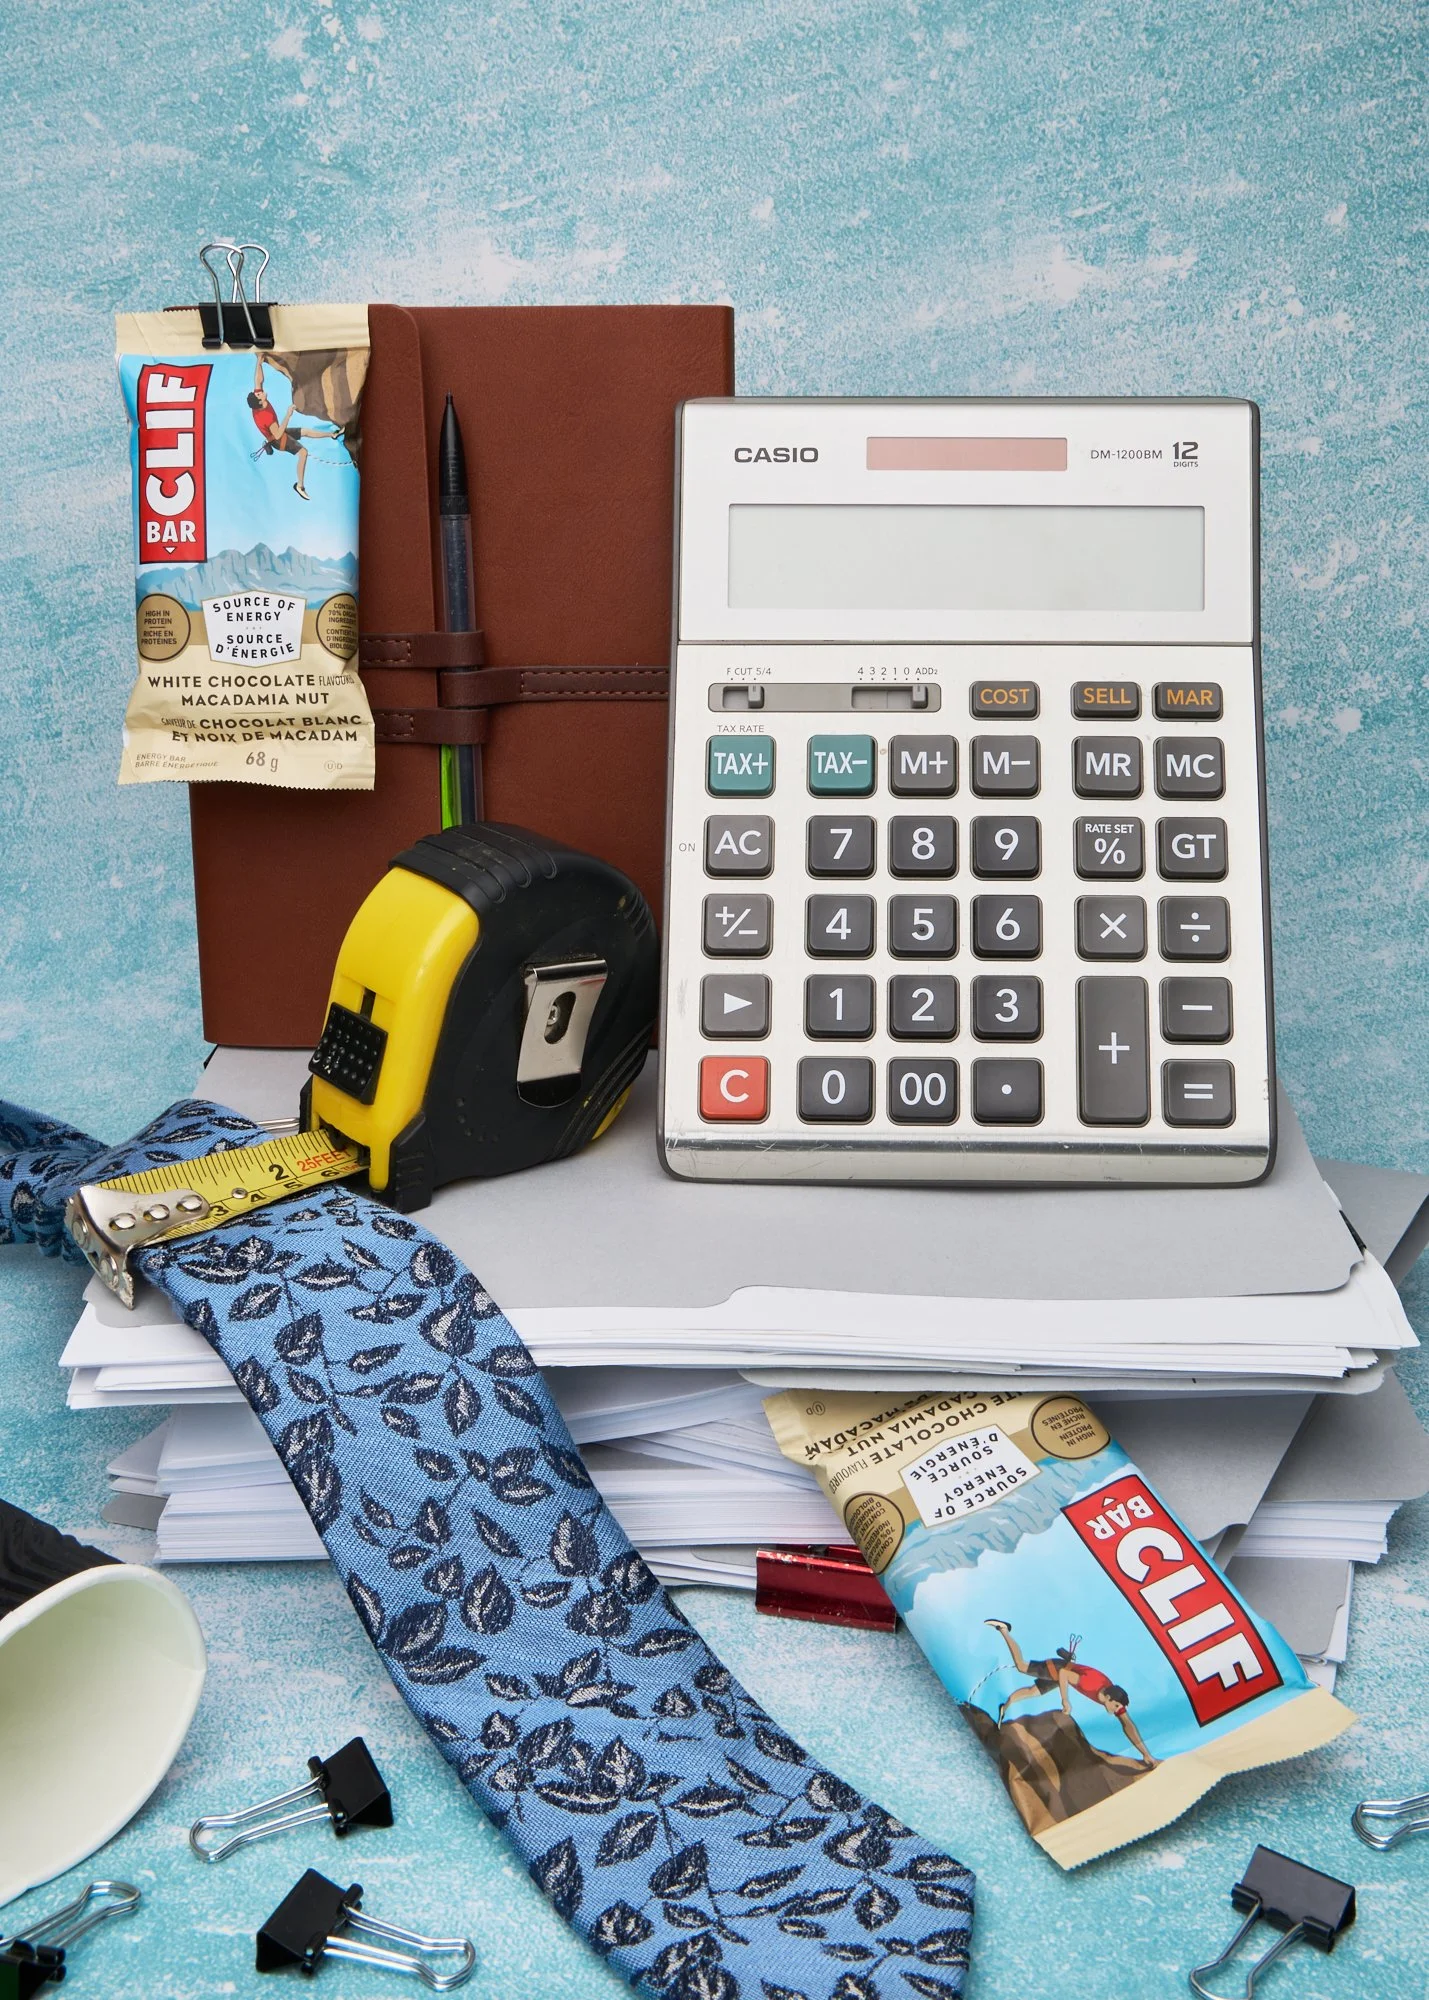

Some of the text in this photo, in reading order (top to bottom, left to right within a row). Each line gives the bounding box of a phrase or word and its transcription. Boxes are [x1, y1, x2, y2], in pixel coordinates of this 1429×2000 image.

[145, 372, 197, 517] CLIF
[734, 447, 819, 463] CASIO
[1090, 449, 1163, 460] DM-1200BM
[1172, 441, 1199, 460] 12
[146, 520, 197, 544] BAR
[212, 596, 296, 613] SOURCE OF
[226, 611, 281, 622] ENERGY
[215, 642, 295, 659] D'ÉNERGIE
[226, 633, 283, 645] SOURCE
[147, 675, 202, 688] WHITE
[208, 674, 316, 688] CHOCOLATE
[726, 667, 772, 675] F CUT 5/4
[857, 666, 864, 675] 4
[869, 666, 876, 675] 3
[881, 666, 887, 675] 2
[181, 692, 329, 706] MACADAMIA NUT
[980, 688, 1030, 705] COST
[1083, 687, 1132, 705] SELL
[1166, 689, 1214, 706] MAR
[186, 719, 197, 729] DE
[199, 717, 296, 729] CHOCOLAT
[302, 715, 362, 726] BLANC
[717, 724, 765, 733] TAX RATE
[171, 729, 358, 743] ET NOIX DE MACADAM
[135, 760, 160, 768] BARRE
[136, 752, 186, 762] ENERGY BAR
[245, 751, 279, 773] 68 g
[713, 752, 769, 775] TAX+
[900, 751, 949, 775] M+
[982, 751, 1031, 775] M-
[1085, 751, 1132, 777] MR
[1166, 753, 1216, 778] MC
[1084, 823, 1135, 834] RATE SET
[678, 842, 696, 853] ON
[713, 829, 762, 856] AC
[829, 828, 853, 860] 7
[911, 827, 936, 860] 8
[994, 828, 1019, 861] 9
[1094, 837, 1126, 865] %
[1171, 832, 1217, 859] GT
[825, 907, 852, 940] 4
[911, 908, 935, 941] 5
[995, 907, 1021, 941] 6
[828, 987, 843, 1021] 1
[911, 987, 935, 1021] 2
[995, 988, 1019, 1023] 3
[719, 1069, 750, 1103] C
[821, 1069, 846, 1105] 0
[899, 1071, 947, 1106] 00
[268, 1163, 290, 1181] 2
[209, 1204, 229, 1217] 3
[250, 1193, 267, 1203] 4
[283, 1181, 304, 1189] 5
[320, 1170, 340, 1178] 6
[847, 1391, 978, 1457] CADAMIA NUT
[1063, 1413, 1086, 1426] RICHE
[869, 1402, 988, 1465] CHOCOLATE
[1059, 1423, 1093, 1441] PROTEIN
[1066, 1430, 1096, 1447] HIGH IN
[910, 1432, 999, 1481] D'ÉNERGIE
[927, 1445, 994, 1483] SOURCE
[828, 1458, 869, 1495] FLAVOURED
[944, 1464, 1008, 1503] ENERGY
[934, 1467, 1028, 1519] SOURCE OF
[860, 1508, 886, 1536] CONTIENT
[1086, 1495, 1154, 1540] BAR
[880, 1526, 896, 1540] 70%
[1115, 1526, 1263, 1690] CLIF
